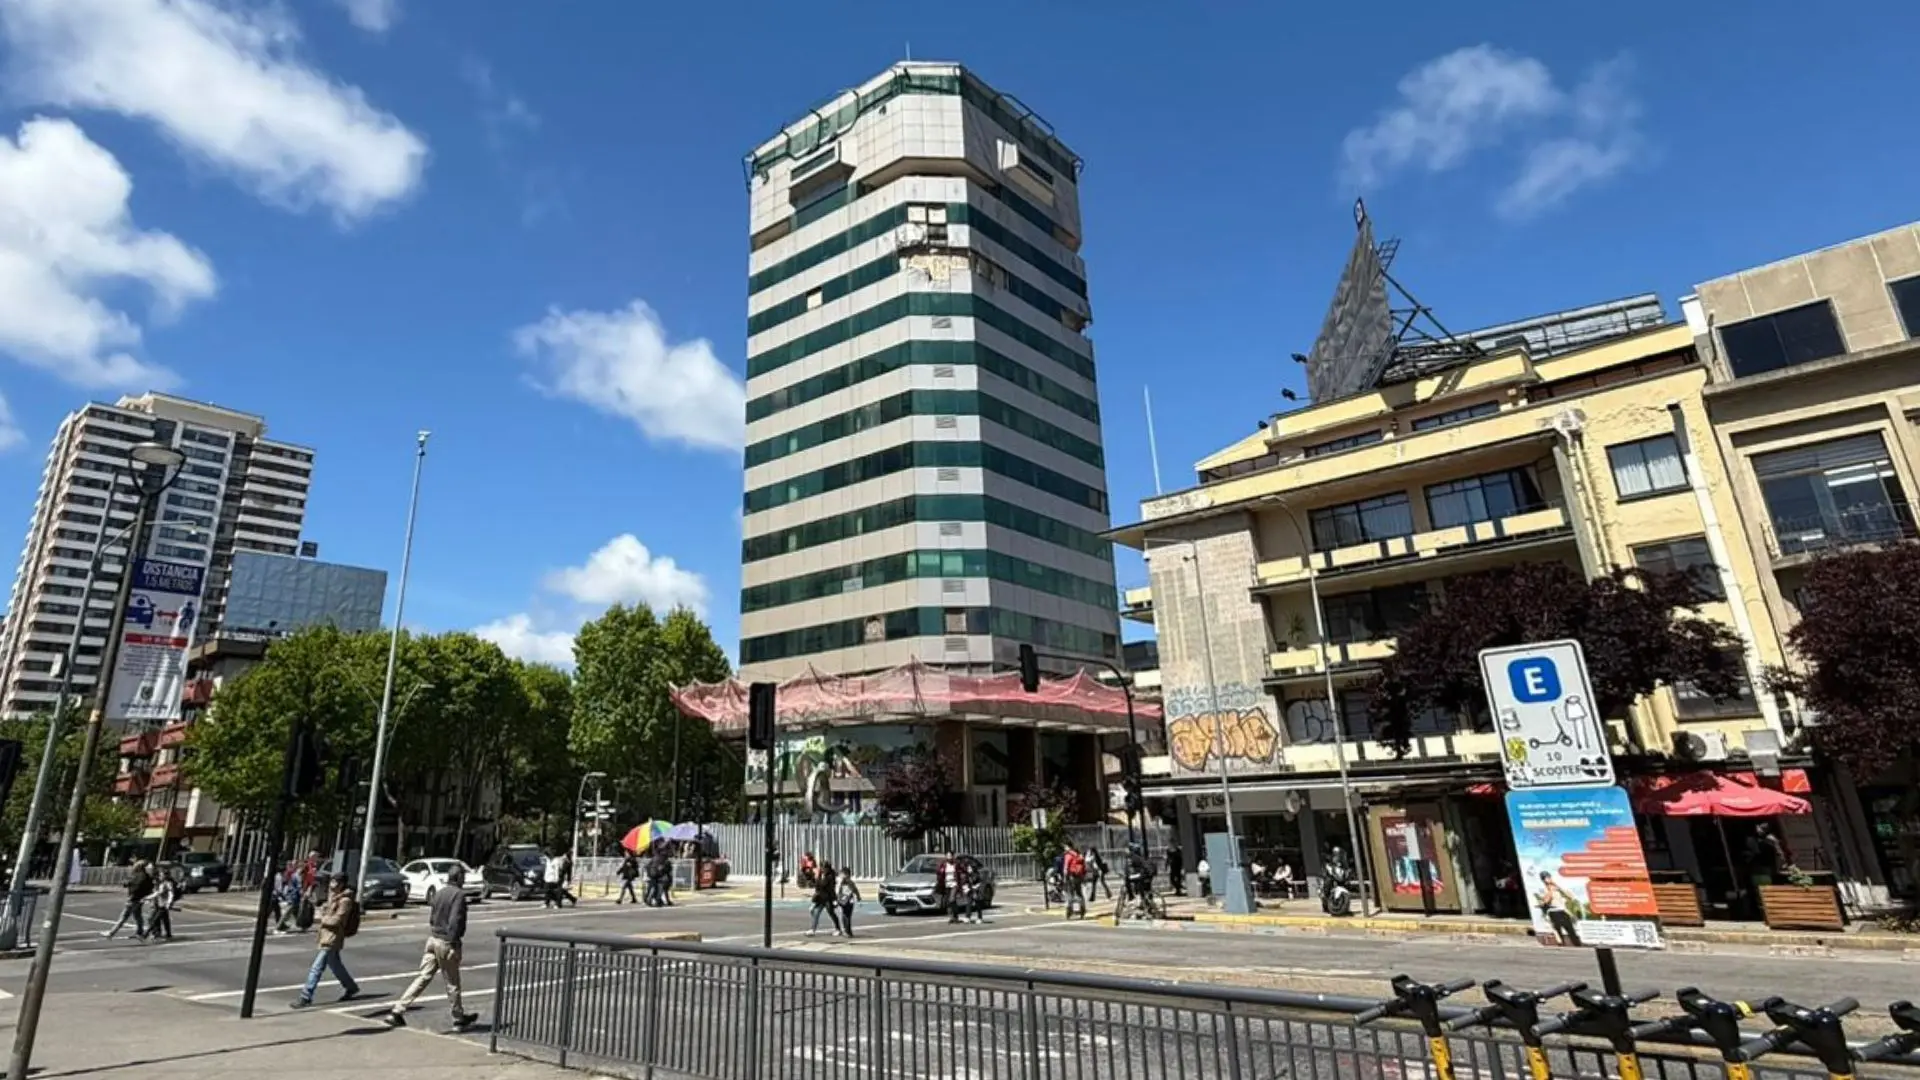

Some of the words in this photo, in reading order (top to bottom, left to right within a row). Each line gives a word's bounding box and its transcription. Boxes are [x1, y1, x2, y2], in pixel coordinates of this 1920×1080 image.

[143, 561, 198, 580] DISTANCIA
[159, 576, 194, 591] METROS
[1523, 667, 1547, 695] E
[1546, 752, 1562, 761] 10
